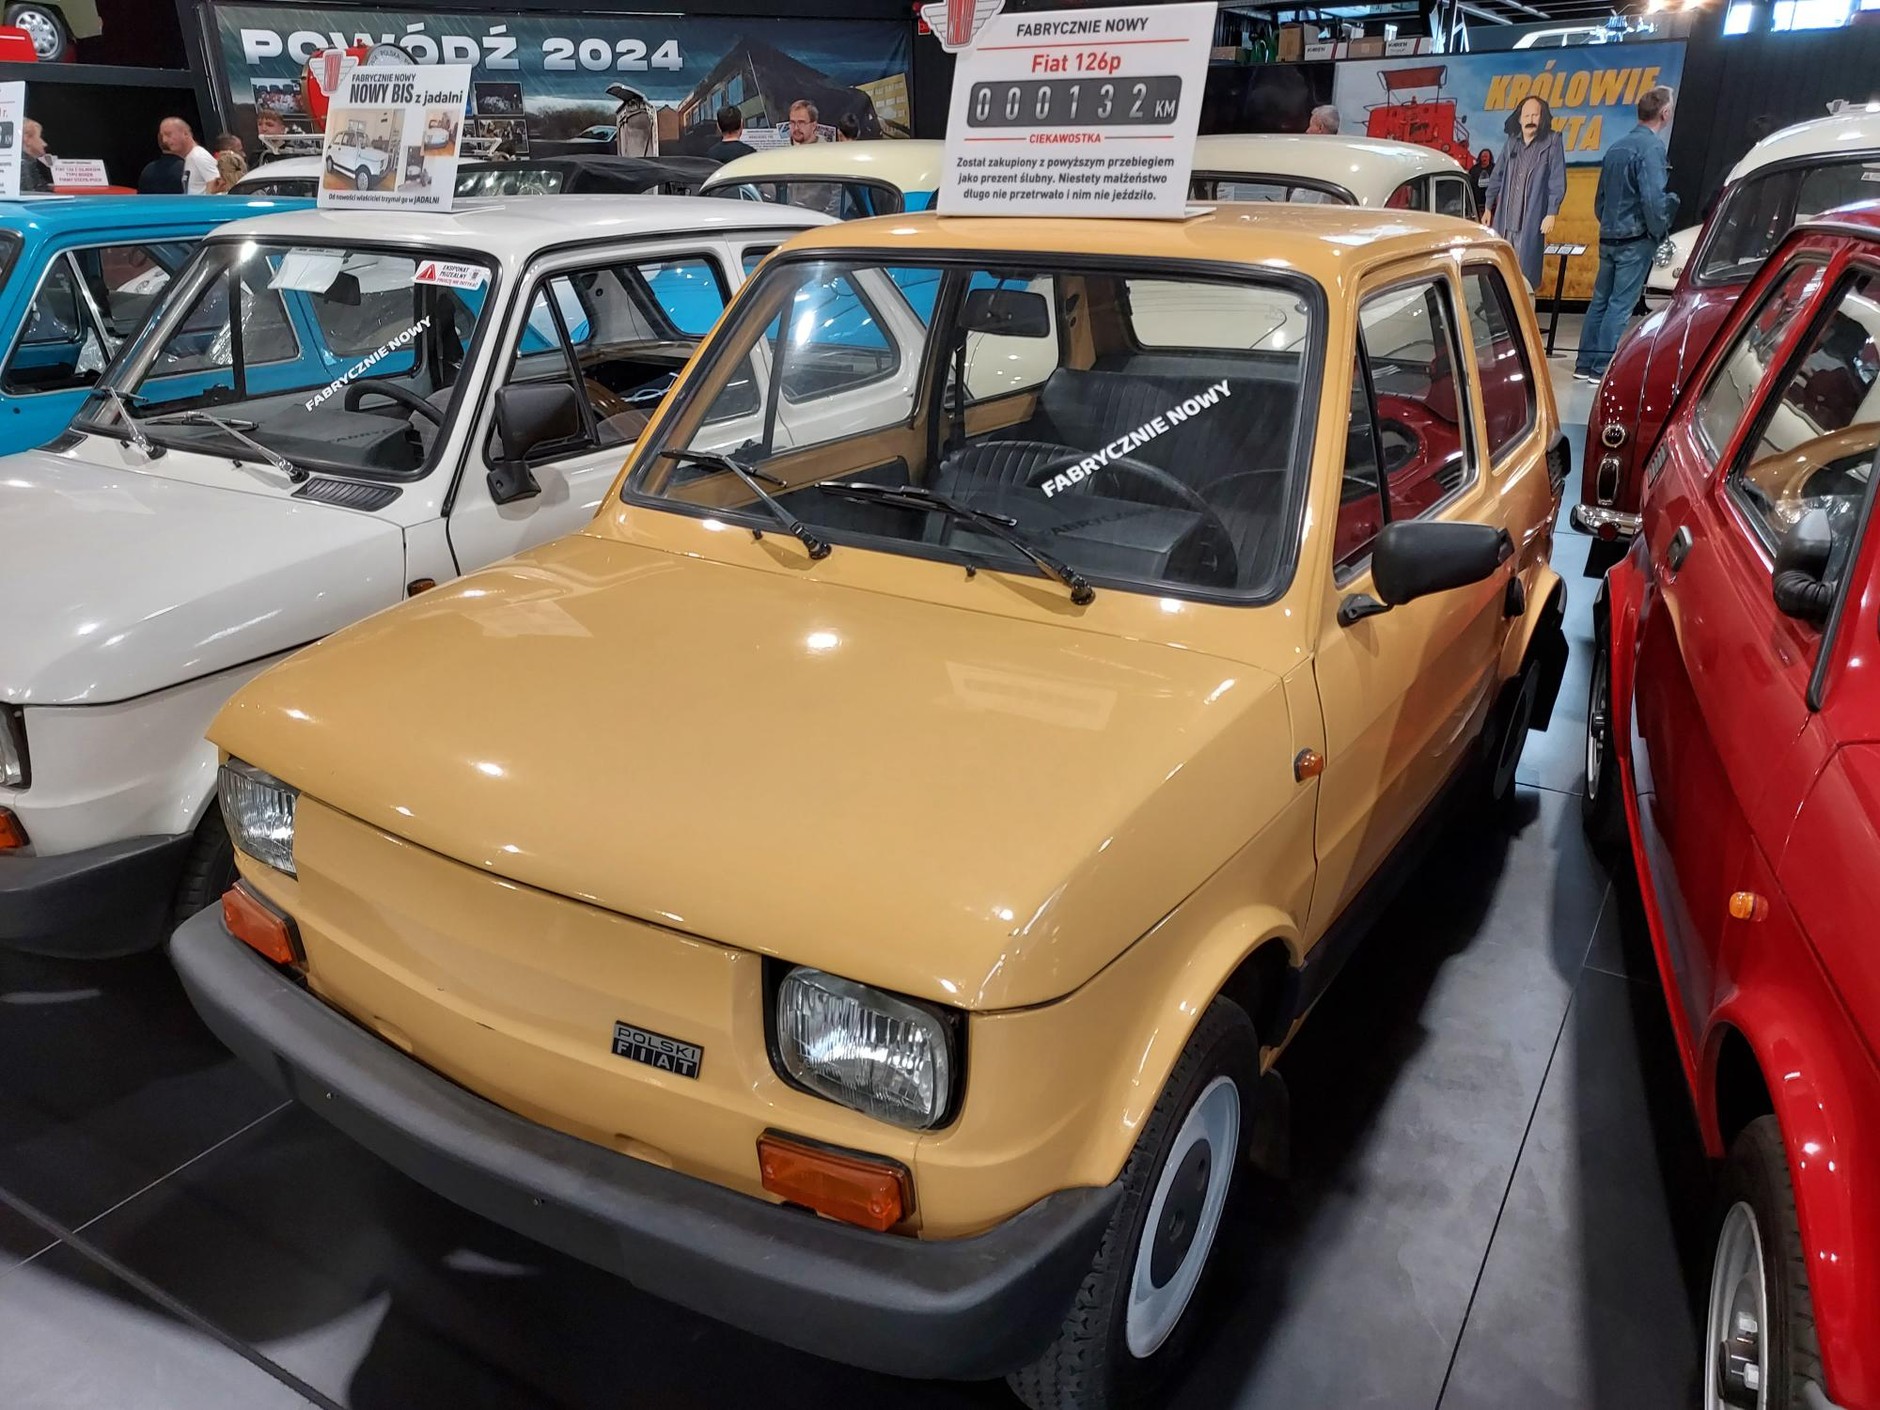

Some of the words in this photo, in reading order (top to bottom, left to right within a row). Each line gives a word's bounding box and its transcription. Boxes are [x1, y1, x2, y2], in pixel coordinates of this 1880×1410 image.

[1016, 20, 1101, 37] FABRYCZNIE
[1105, 17, 1149, 32] NOWY
[541, 37, 683, 71] 2024
[1031, 54, 1068, 73] Fiat
[1075, 52, 1122, 74] 126p
[351, 74, 394, 83] FABRYCZNIE
[394, 73, 417, 82] NOWY
[1484, 60, 1661, 111] KRÓLOWIE
[350, 83, 390, 104] NOWY
[391, 83, 415, 104] BIS
[415, 95, 421, 104] z
[422, 90, 464, 107] jadalni
[1154, 100, 1176, 118] KM
[1029, 133, 1102, 144] CIEKAWOSTKA
[956, 157, 986, 168] Został
[988, 157, 1038, 169] zakupiony
[1039, 159, 1045, 167] z
[1047, 156, 1105, 169] powyższym
[1107, 156, 1174, 169] przebiegiem
[958, 173, 979, 185] jako
[980, 174, 1018, 186] prezent
[1019, 172, 1055, 186] ślubny.
[1058, 173, 1101, 185] Niestety
[1103, 172, 1167, 184] małżeństwo
[963, 188, 991, 201] długo
[992, 189, 1008, 200] nie
[1009, 189, 1065, 201] przetrwało
[1072, 189, 1092, 200] nim
[1094, 189, 1111, 200] nie
[1112, 188, 1157, 202] jeździło.
[304, 347, 390, 413] FABRYCZNIE
[388, 315, 432, 351] NOWY
[1041, 416, 1170, 498] FABRYCZNIE
[1165, 379, 1232, 426] NOWY
[618, 1027, 696, 1060] POLSKI
[616, 1040, 694, 1075] FIAT
